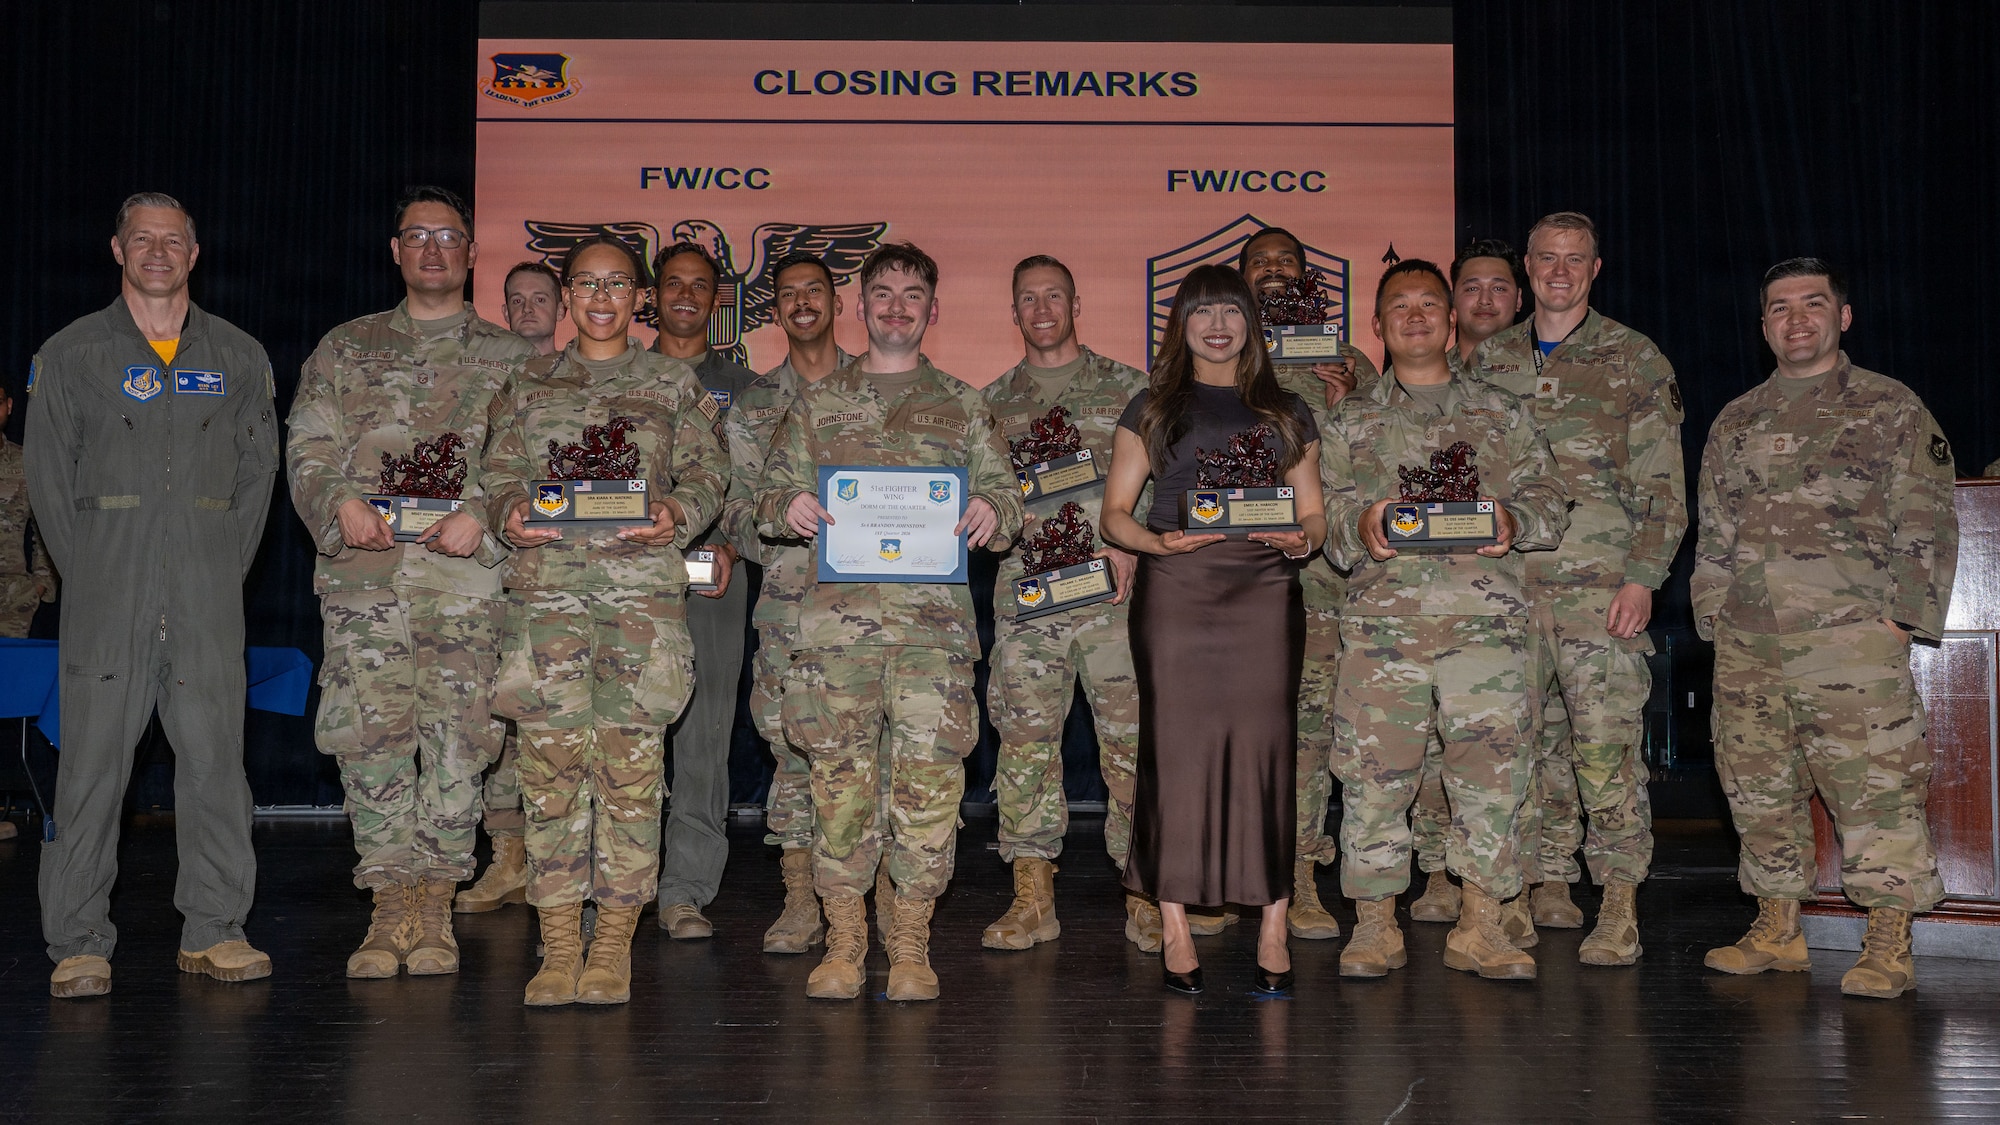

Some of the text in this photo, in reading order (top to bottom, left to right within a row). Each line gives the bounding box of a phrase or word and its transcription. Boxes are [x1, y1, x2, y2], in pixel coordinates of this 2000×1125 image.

[753, 69, 1199, 97] CLOSING REMARKS
[485, 89, 519, 104] LEADING
[541, 89, 574, 103] CHARGE
[640, 166, 772, 190] FW/CC
[1167, 169, 1328, 193] FW/CCC
[351, 350, 391, 359] MARCELINO
[478, 358, 488, 366] AIR
[488, 359, 510, 372] FORCE
[526, 390, 554, 404] WATKINS
[643, 390, 656, 400] AIR
[656, 392, 676, 410] FORCE
[767, 406, 785, 416] CRUZ
[1096, 407, 1107, 416] AIR
[1107, 408, 1124, 416] FORC
[816, 412, 863, 427] JOHNSTONE
[917, 415, 966, 433] U.S. AIR FORCE
